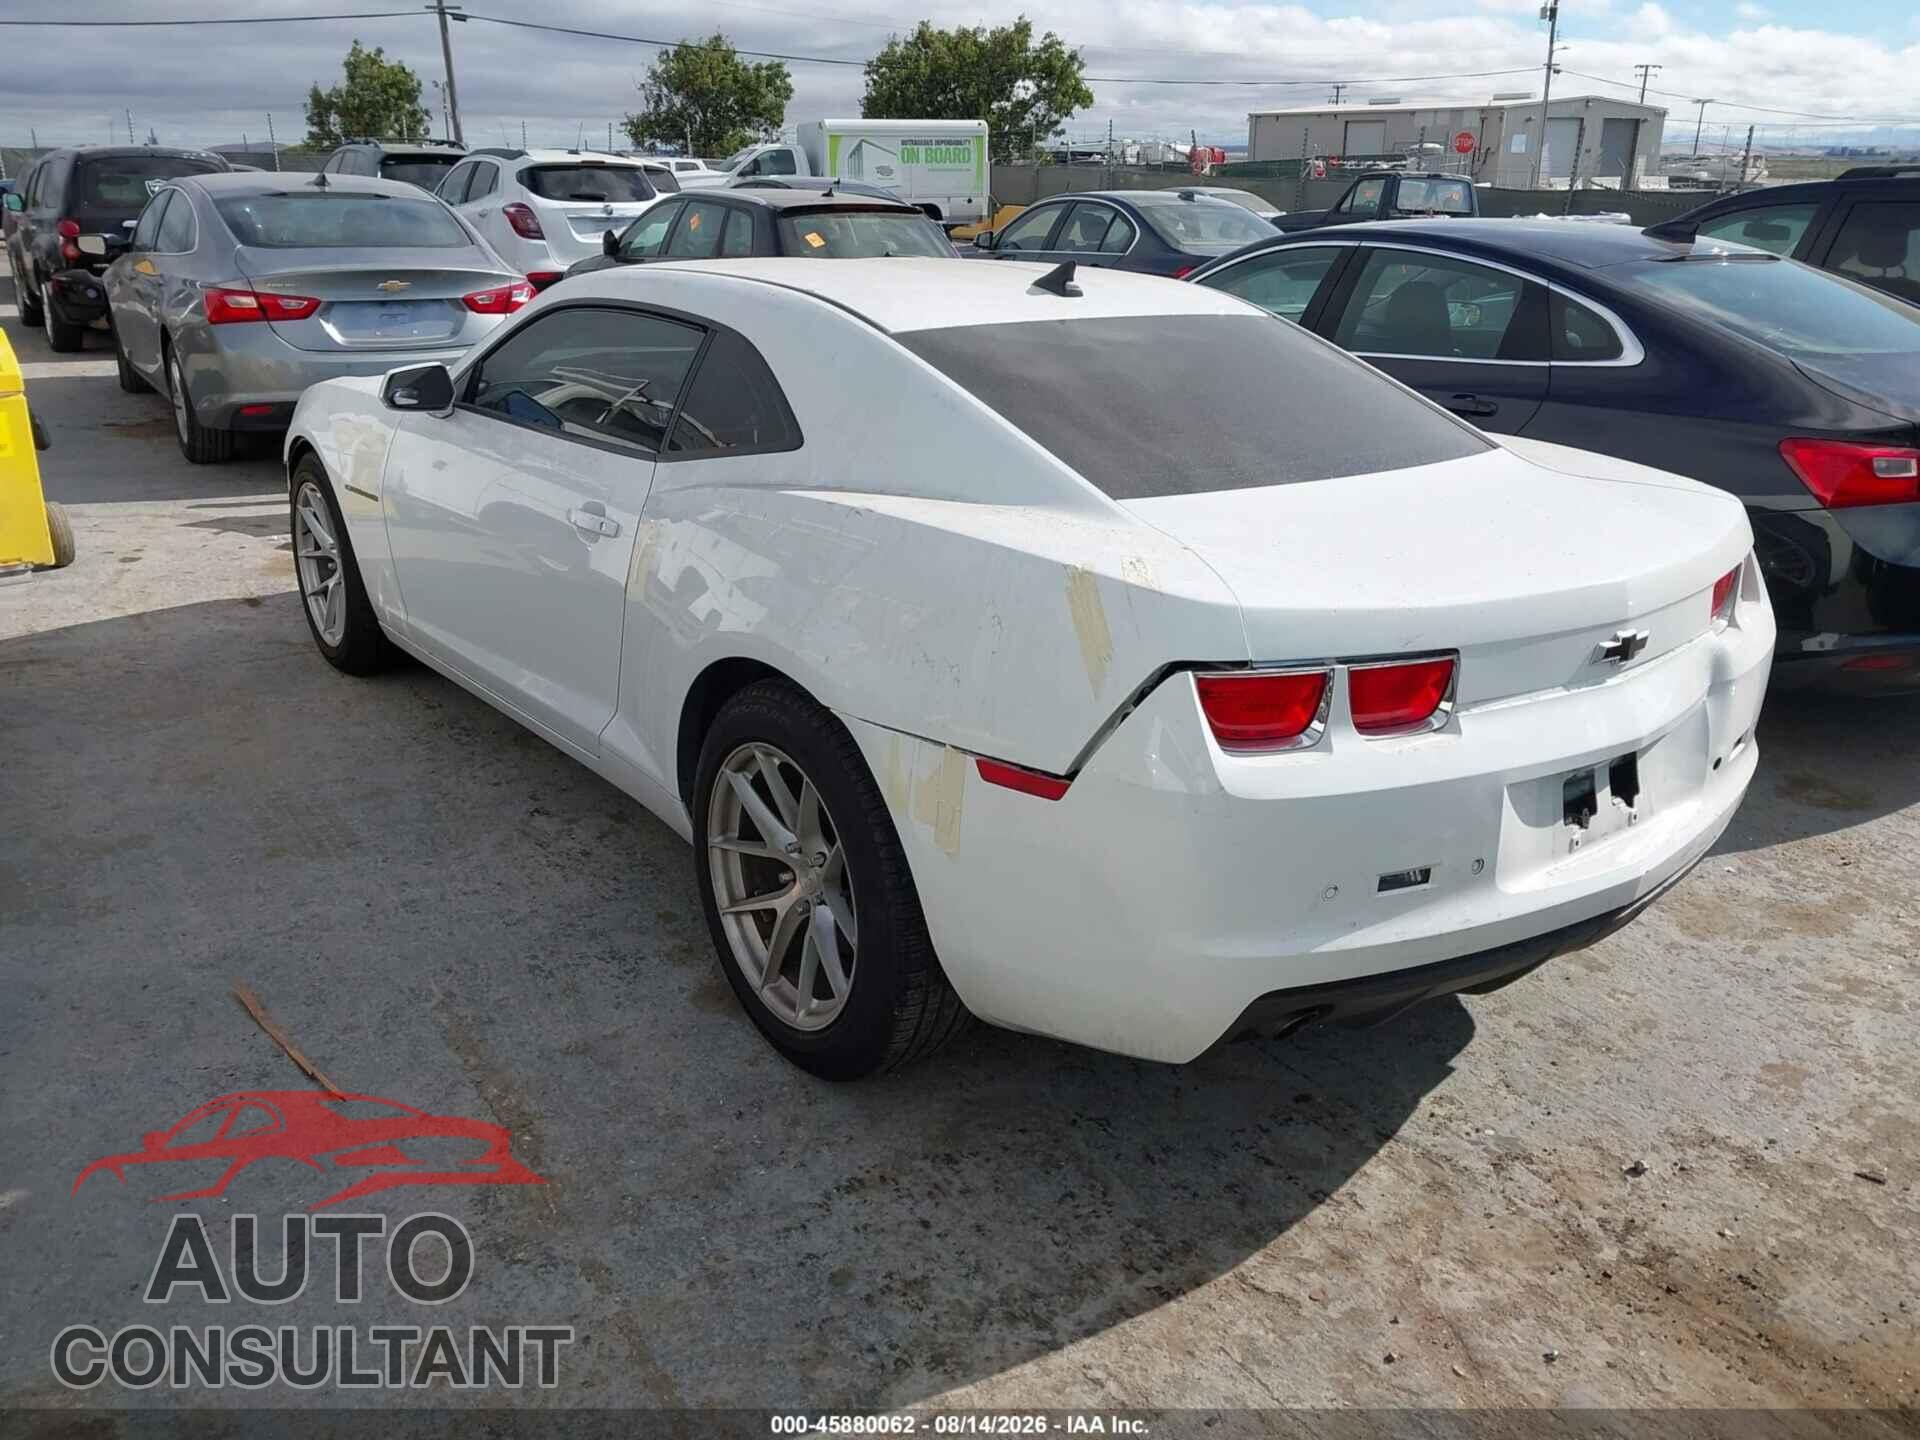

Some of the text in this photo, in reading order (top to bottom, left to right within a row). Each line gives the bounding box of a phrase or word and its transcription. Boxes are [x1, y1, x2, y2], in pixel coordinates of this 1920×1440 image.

[1455, 138, 1472, 147] STOP
[901, 146, 971, 164] ON BOARD
